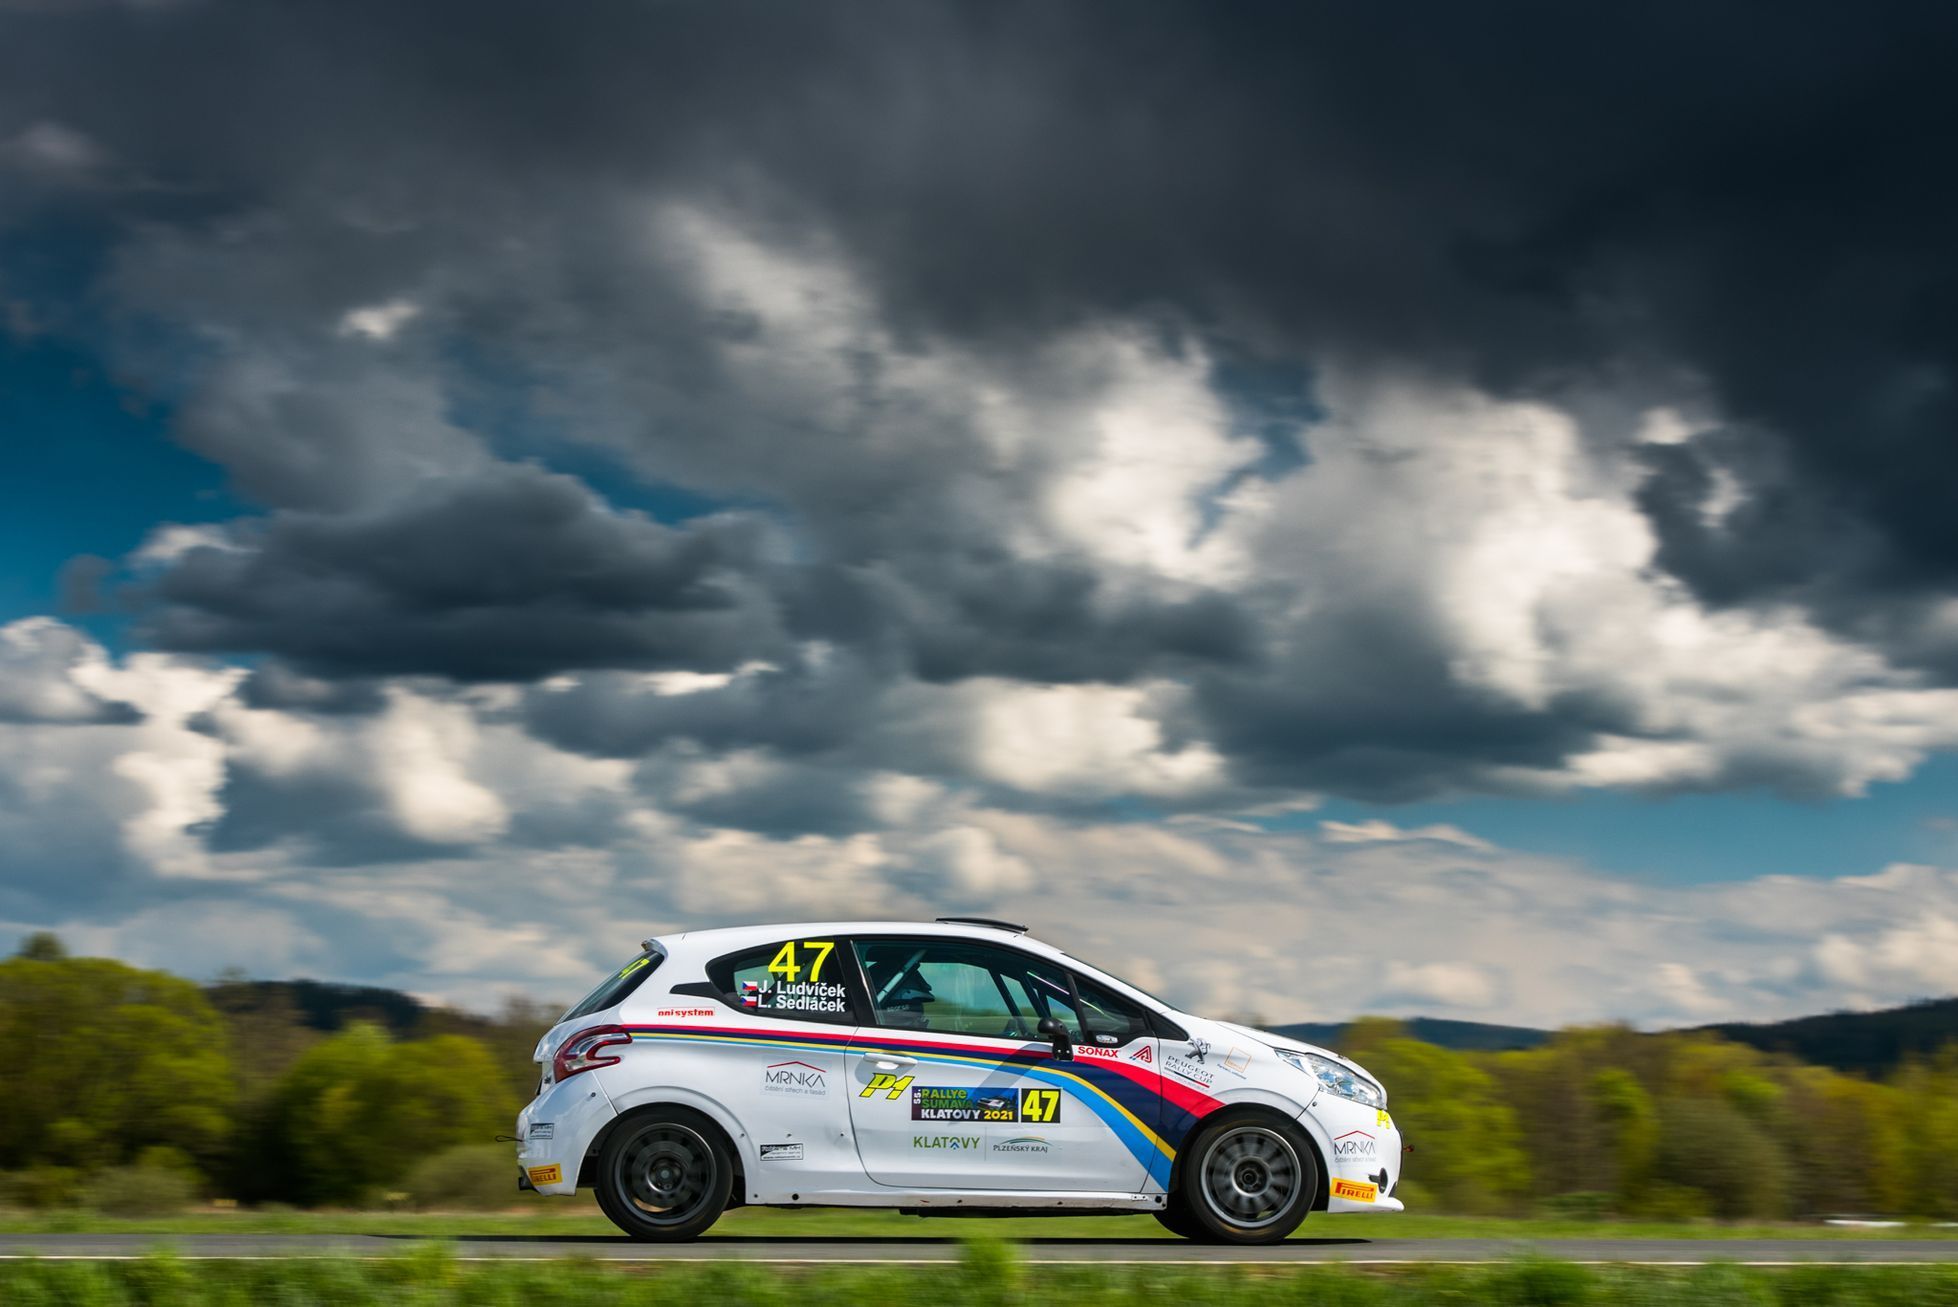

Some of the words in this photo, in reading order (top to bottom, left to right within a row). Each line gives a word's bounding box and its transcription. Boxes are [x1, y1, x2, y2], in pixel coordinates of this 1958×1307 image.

[768, 942, 835, 983] 47
[758, 979, 772, 994] J.
[777, 980, 846, 998] Ludvíček
[757, 993, 772, 1009] L.
[776, 994, 846, 1013] Sedláček
[1078, 1046, 1119, 1058] SONAX
[1165, 1061, 1191, 1075] RALLY
[1193, 1072, 1213, 1083] CUP
[1167, 1055, 1214, 1079] PEUGEOT
[765, 1070, 826, 1088] MRNKA
[859, 1072, 915, 1100] P1
[921, 1109, 981, 1119] KLATOVY
[983, 1110, 1013, 1120] 2021
[1022, 1090, 1060, 1122] 47
[913, 1136, 981, 1150] KLATOVY
[1335, 1182, 1375, 1199] PIRELLI
